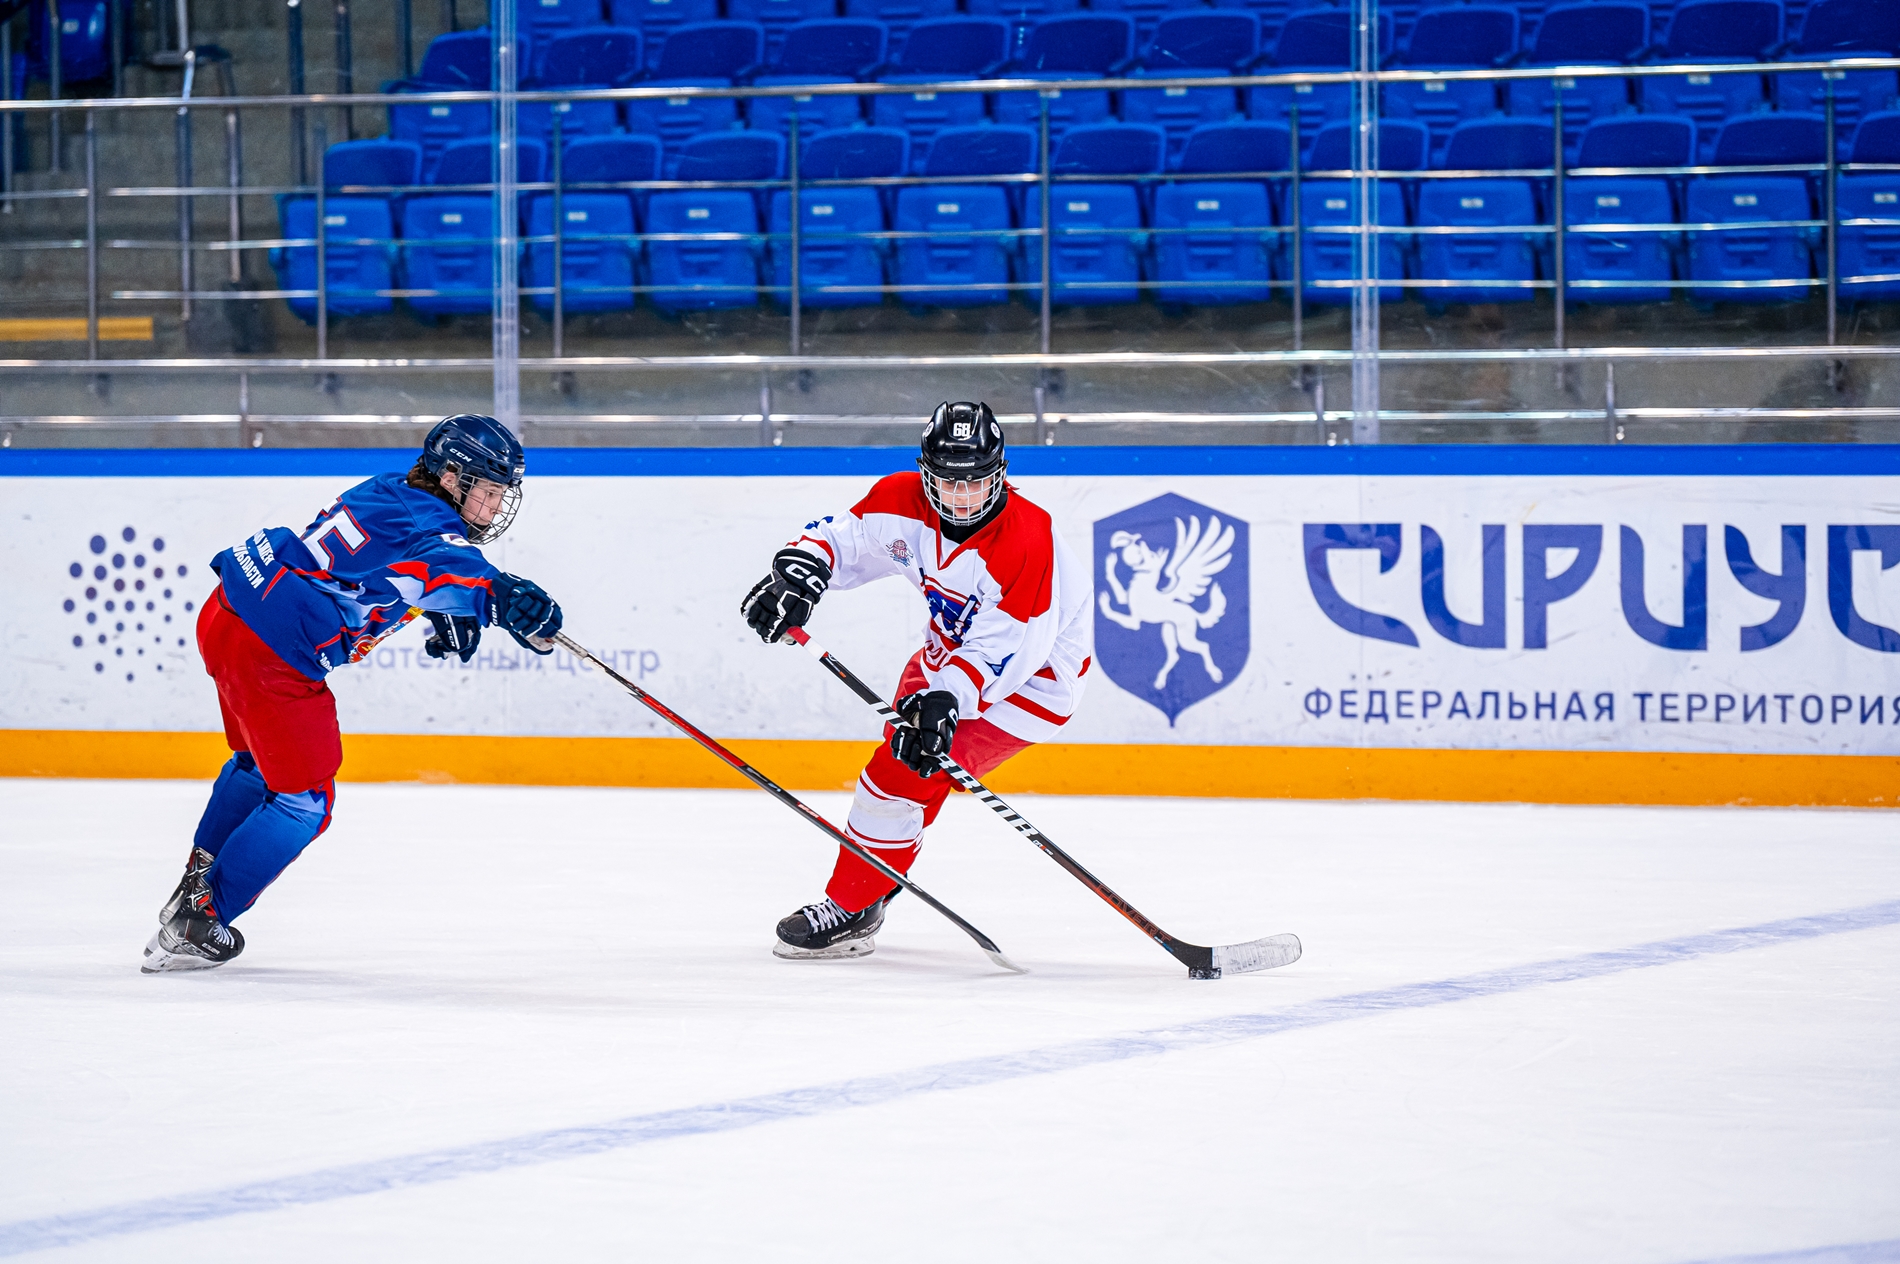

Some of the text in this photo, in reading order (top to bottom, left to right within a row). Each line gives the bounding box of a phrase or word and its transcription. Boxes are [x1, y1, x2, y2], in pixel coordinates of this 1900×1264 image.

[953, 422, 970, 437] 68
[449, 447, 472, 463] CCM
[1303, 523, 1900, 653] СИРИУС
[447, 629, 456, 647] CCM
[1303, 686, 1615, 725] ФЕДЕРАЛЬНАЯ
[870, 700, 1039, 836] WRRIOR
[1098, 884, 1172, 941] COVERT
